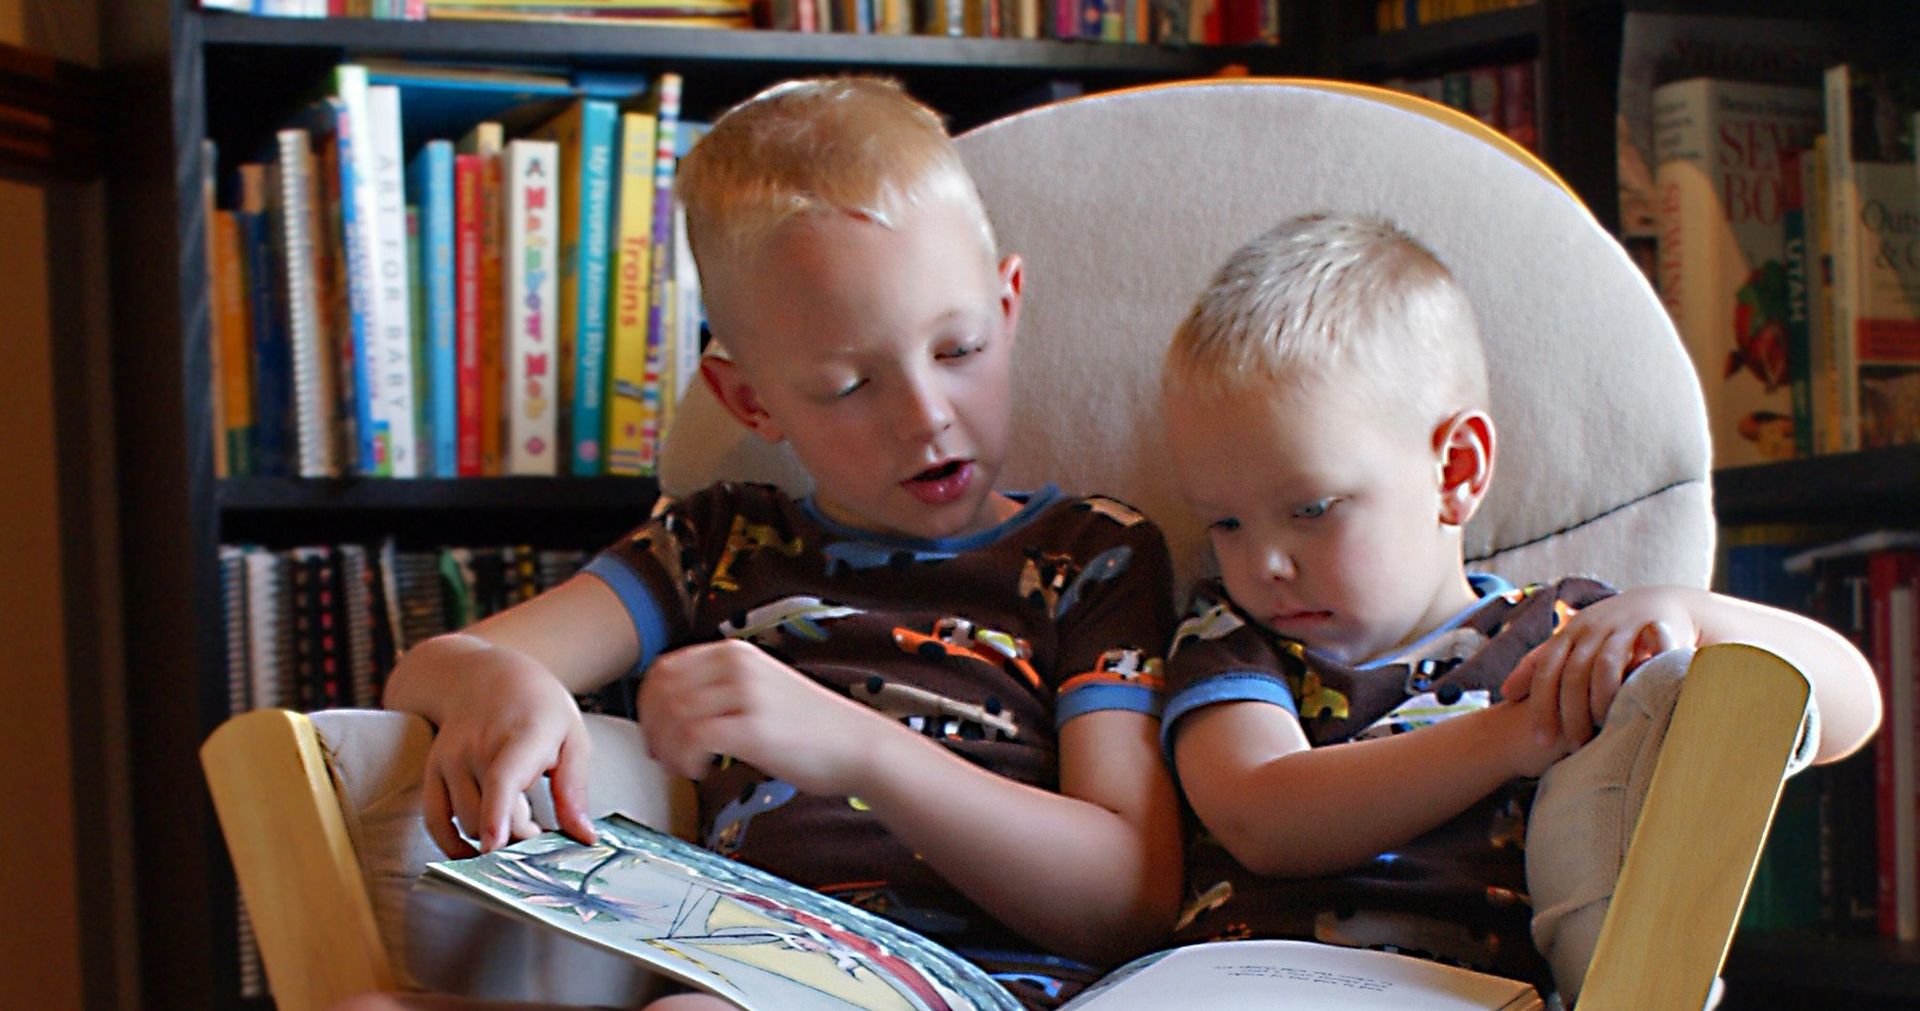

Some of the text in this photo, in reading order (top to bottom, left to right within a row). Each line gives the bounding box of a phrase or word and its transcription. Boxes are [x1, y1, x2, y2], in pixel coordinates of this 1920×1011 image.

[375, 154, 409, 410] ART FOR BABY
[618, 233, 649, 328] Trains
[1788, 238, 1805, 322] UTAH
